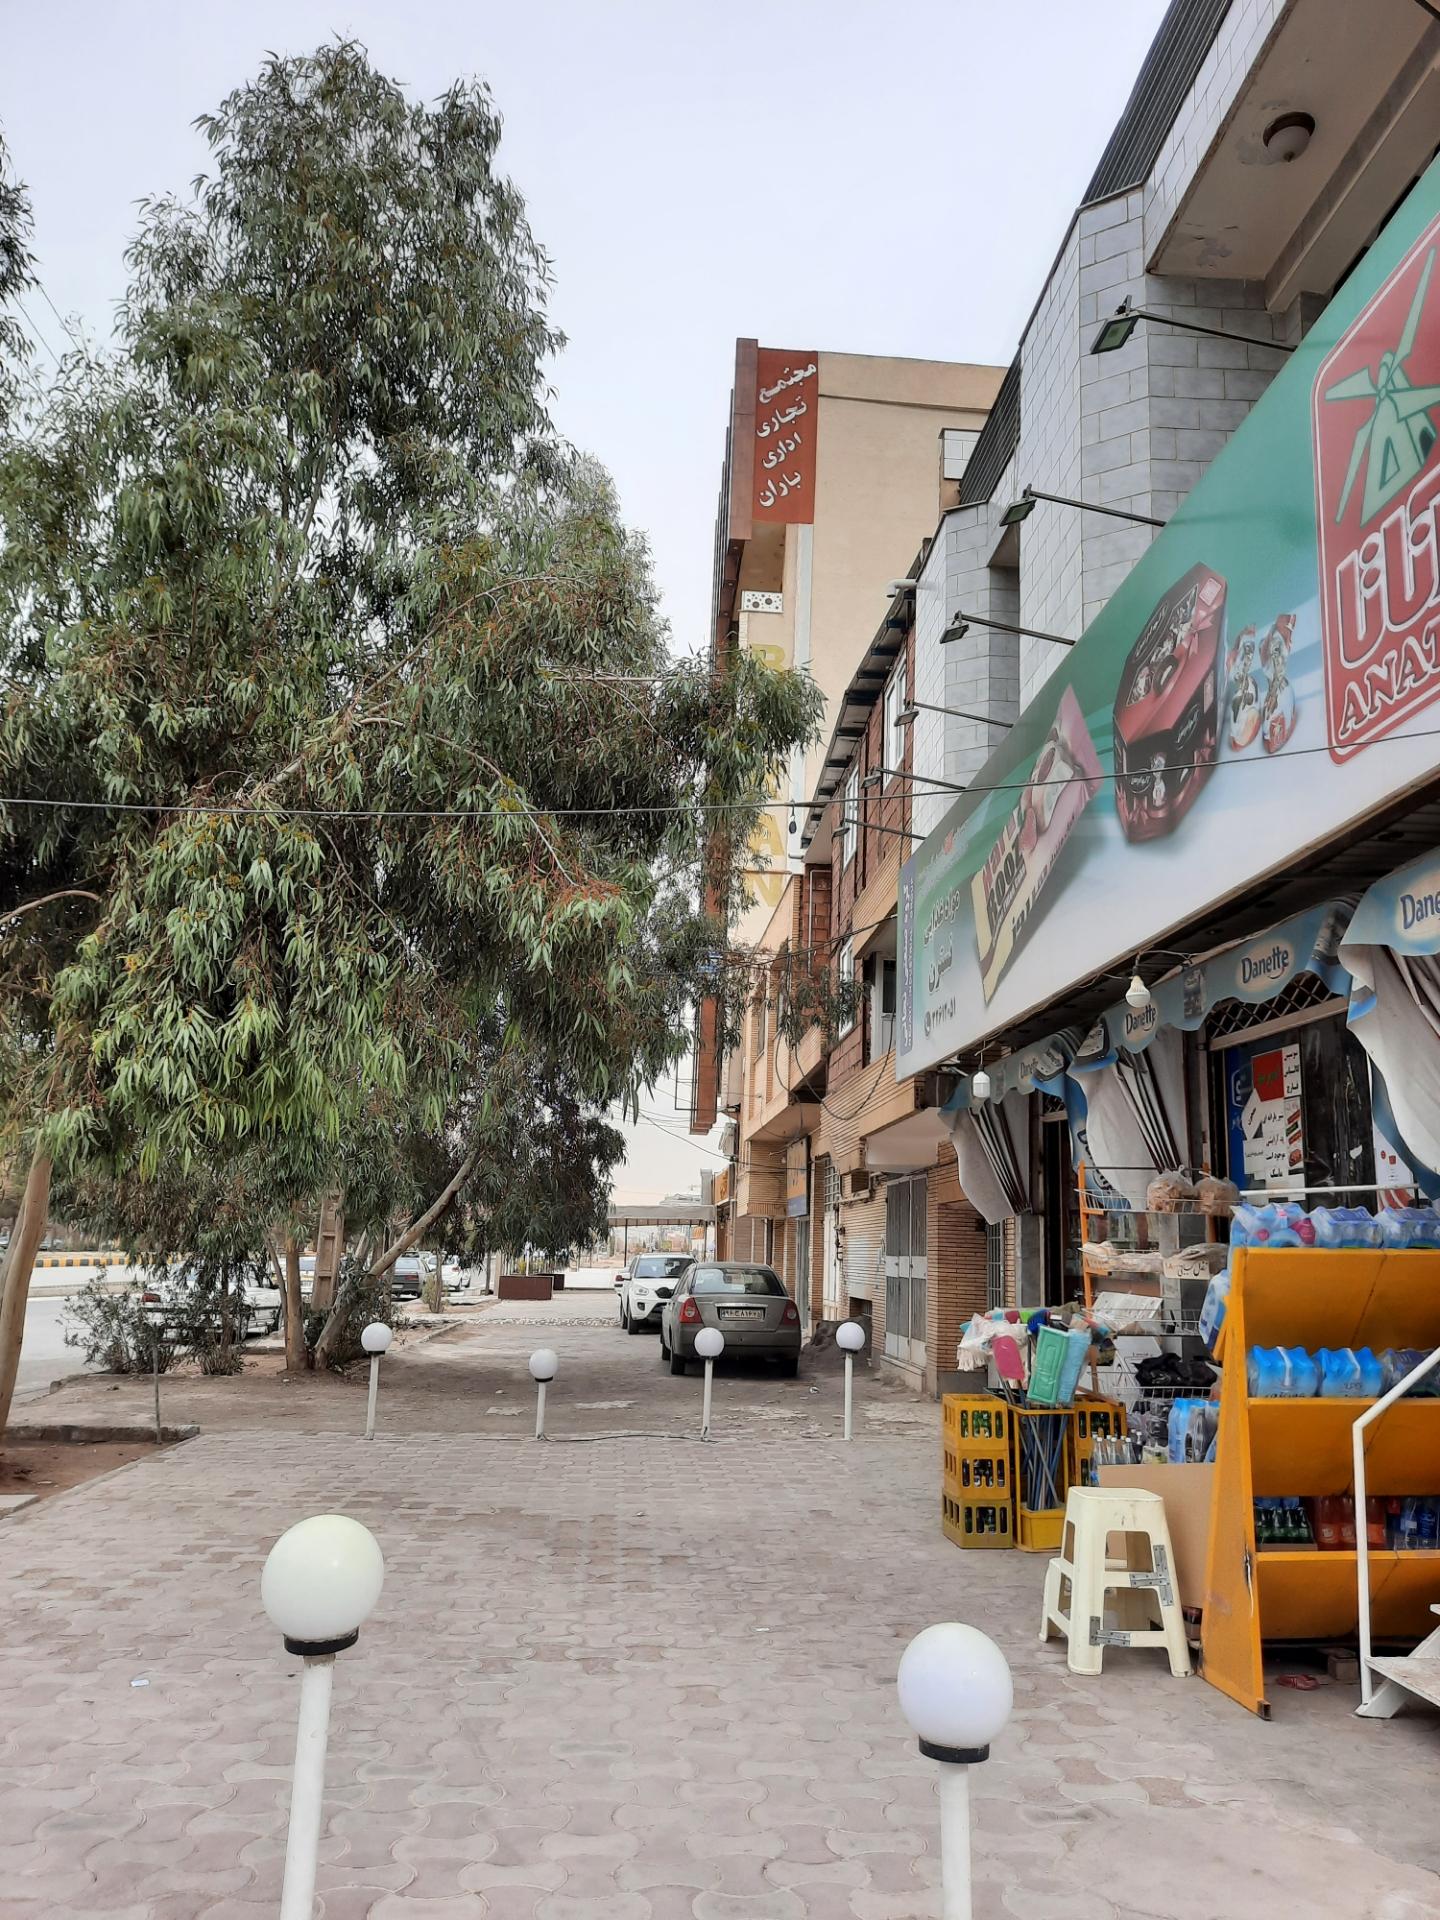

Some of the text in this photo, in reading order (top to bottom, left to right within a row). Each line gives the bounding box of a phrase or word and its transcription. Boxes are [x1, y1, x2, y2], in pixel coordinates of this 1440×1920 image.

[759, 364, 816, 403] مجتمع
[756, 396, 807, 438] تجاری
[762, 431, 802, 469] اداری
[759, 470, 802, 507] باران
[1399, 890, 1440, 930] Dane
[1241, 945, 1289, 984] Danette
